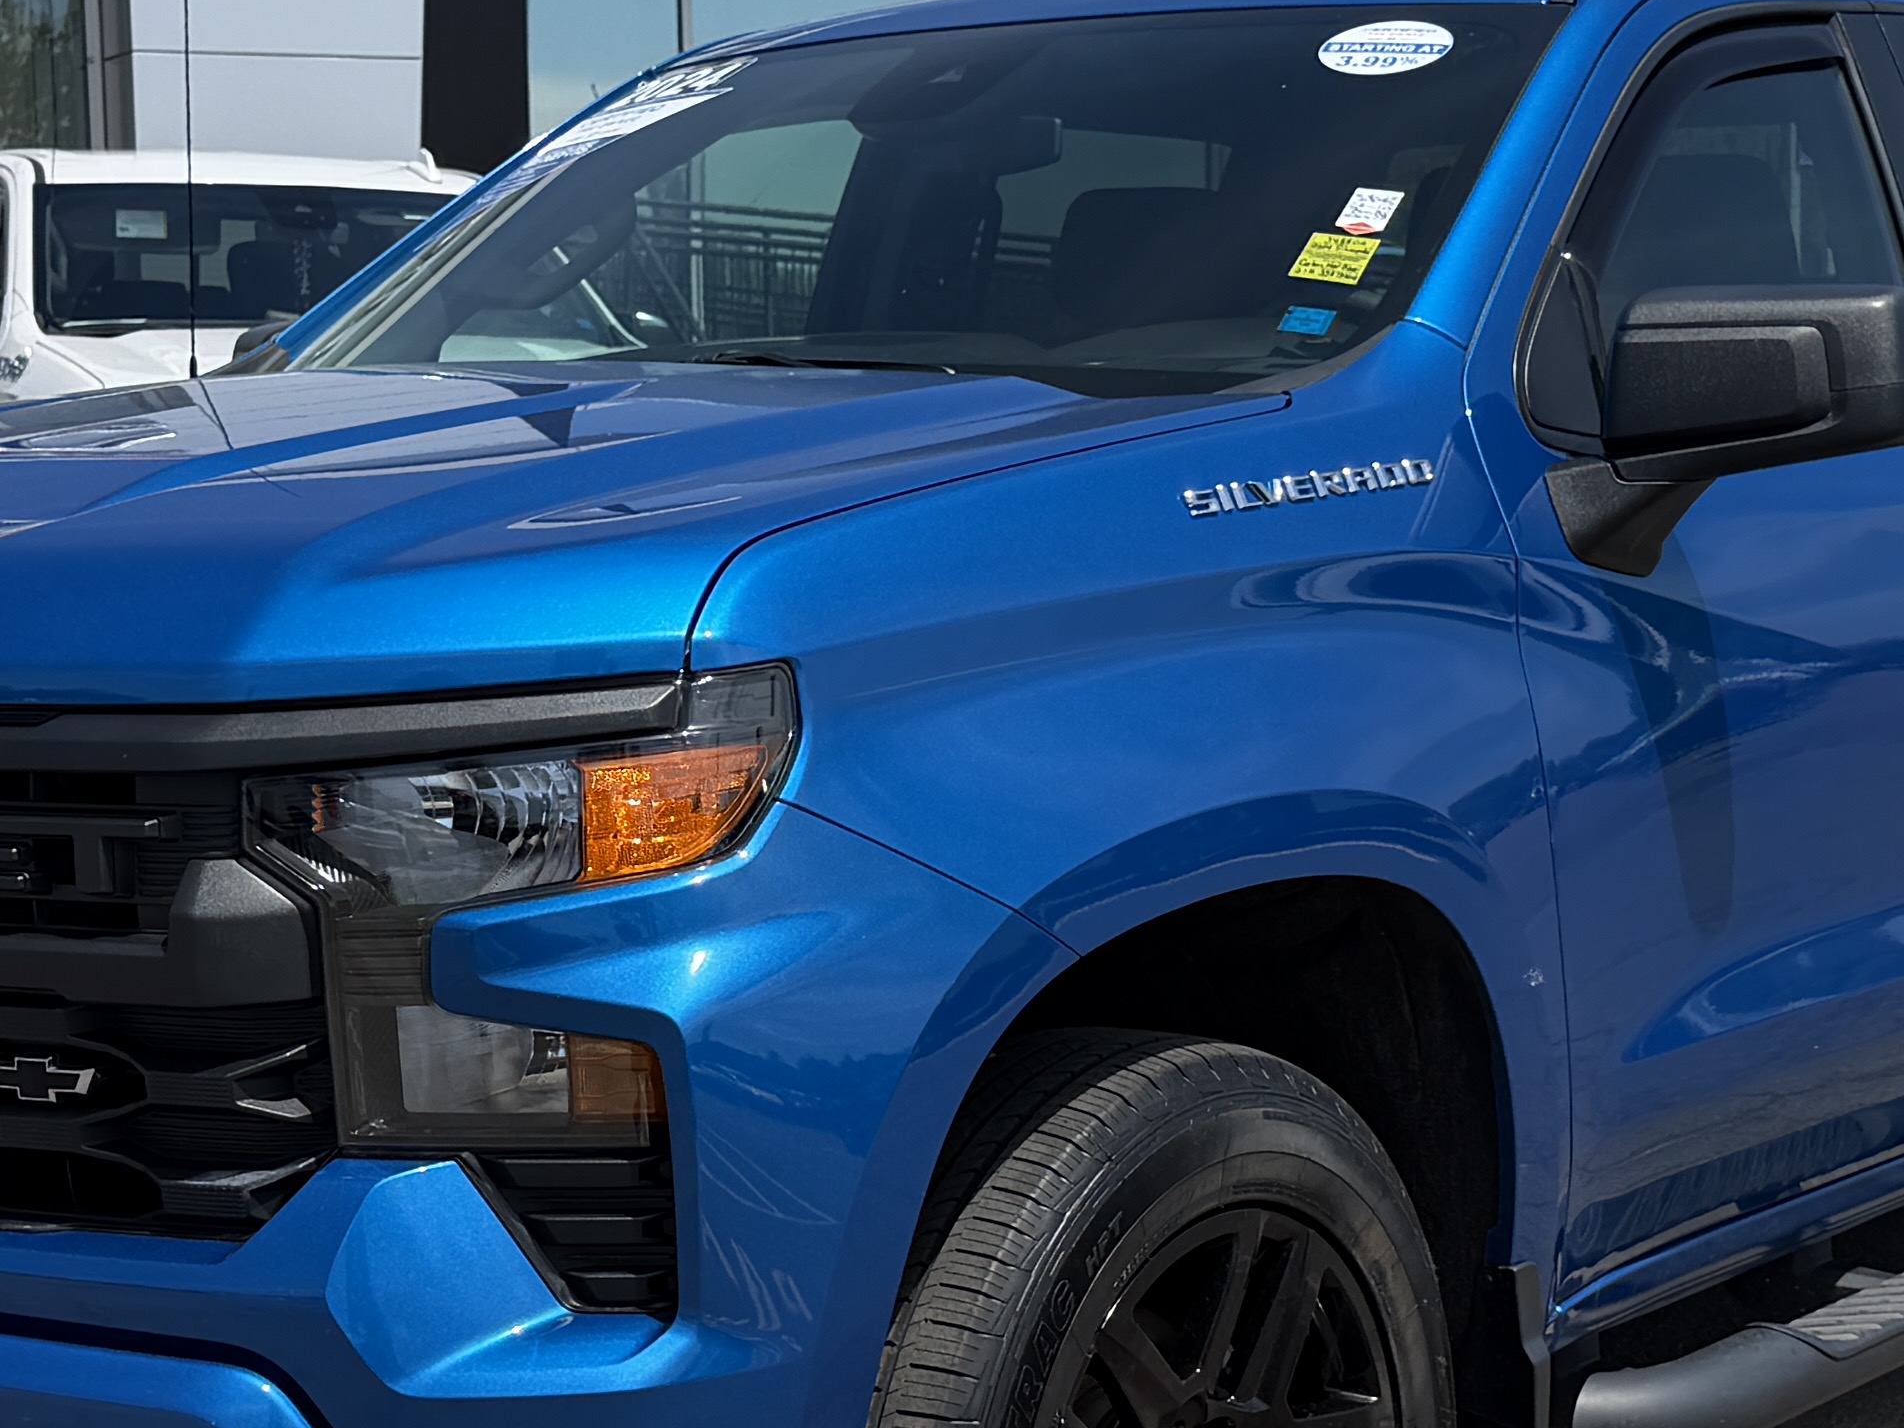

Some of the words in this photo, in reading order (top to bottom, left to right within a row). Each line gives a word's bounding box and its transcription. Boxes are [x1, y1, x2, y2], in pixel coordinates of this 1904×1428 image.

[1328, 43, 1416, 53] STARTING
[1418, 44, 1446, 54] AT
[1183, 458, 1434, 517] SILVERADO
